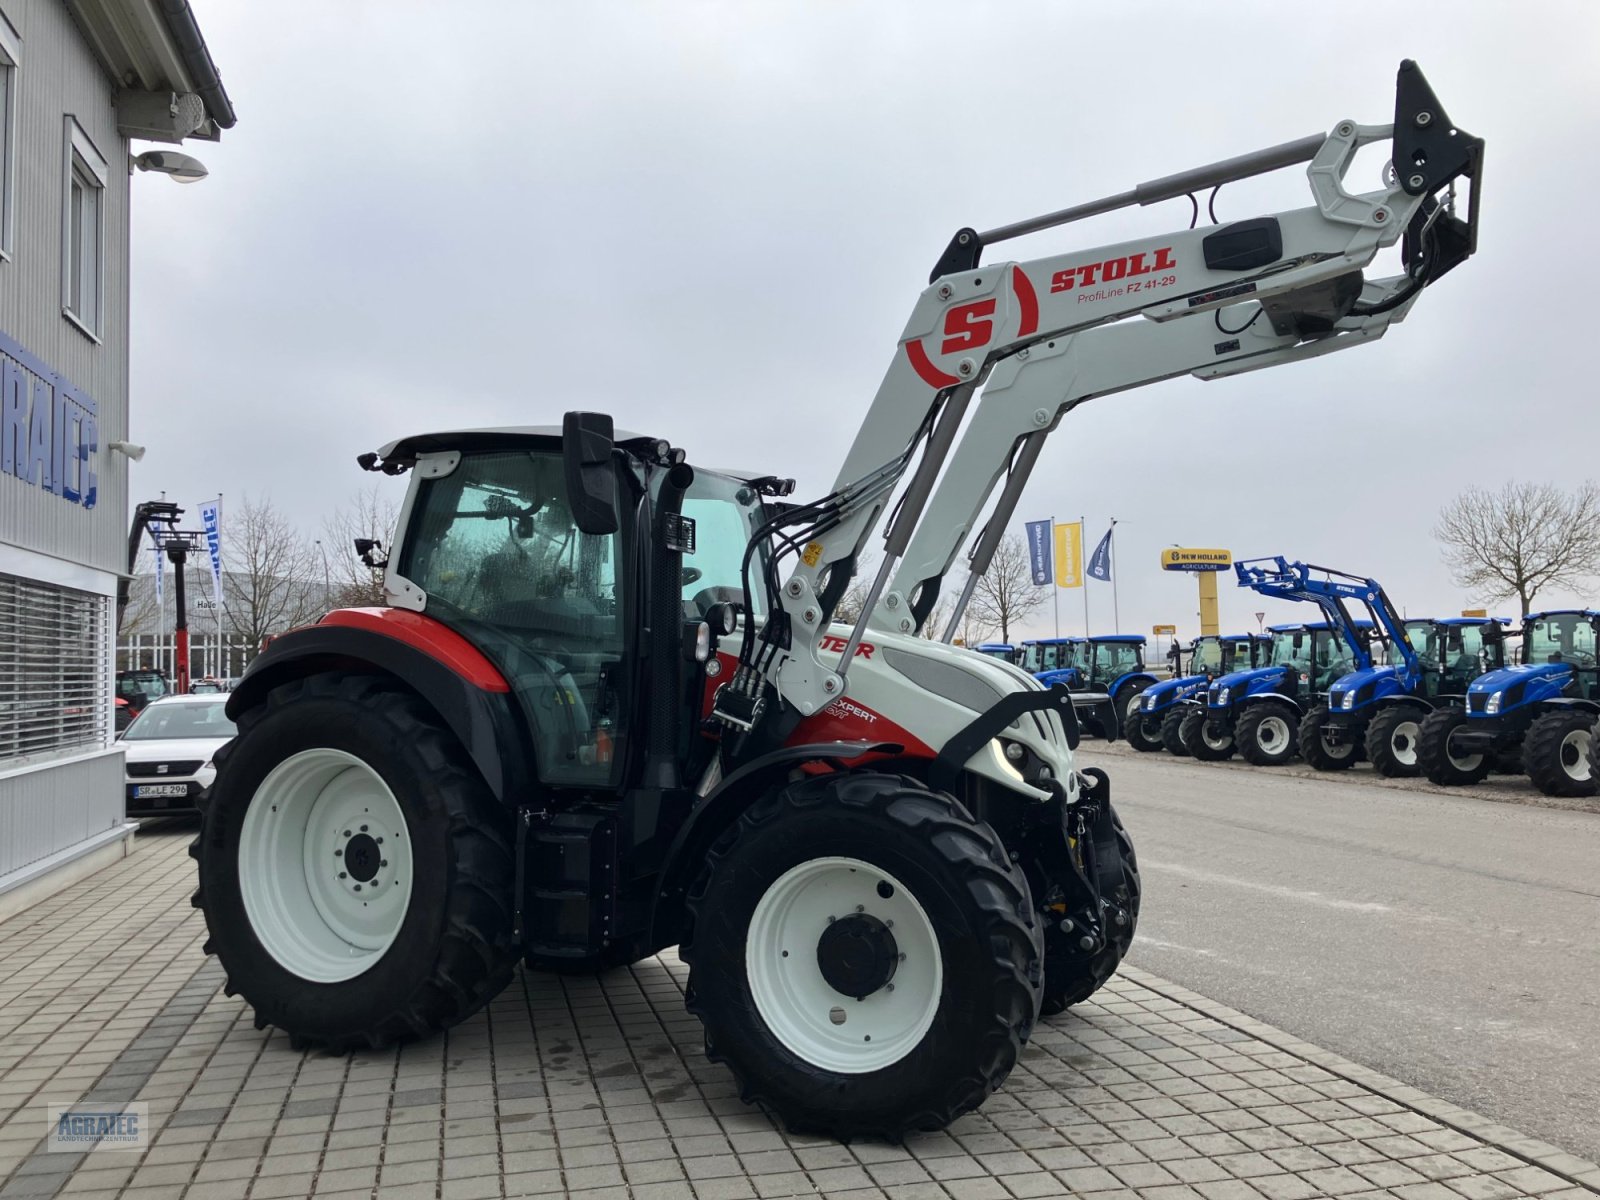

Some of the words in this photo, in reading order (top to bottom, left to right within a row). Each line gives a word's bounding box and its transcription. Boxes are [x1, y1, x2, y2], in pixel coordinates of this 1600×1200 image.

[1050, 247, 1177, 293] STOLL
[1077, 288, 1124, 304] ProfiLine
[1126, 282, 1142, 293] FZ
[1144, 275, 1176, 289] 41-29
[941, 298, 996, 355] S
[169, 785, 187, 794] 296
